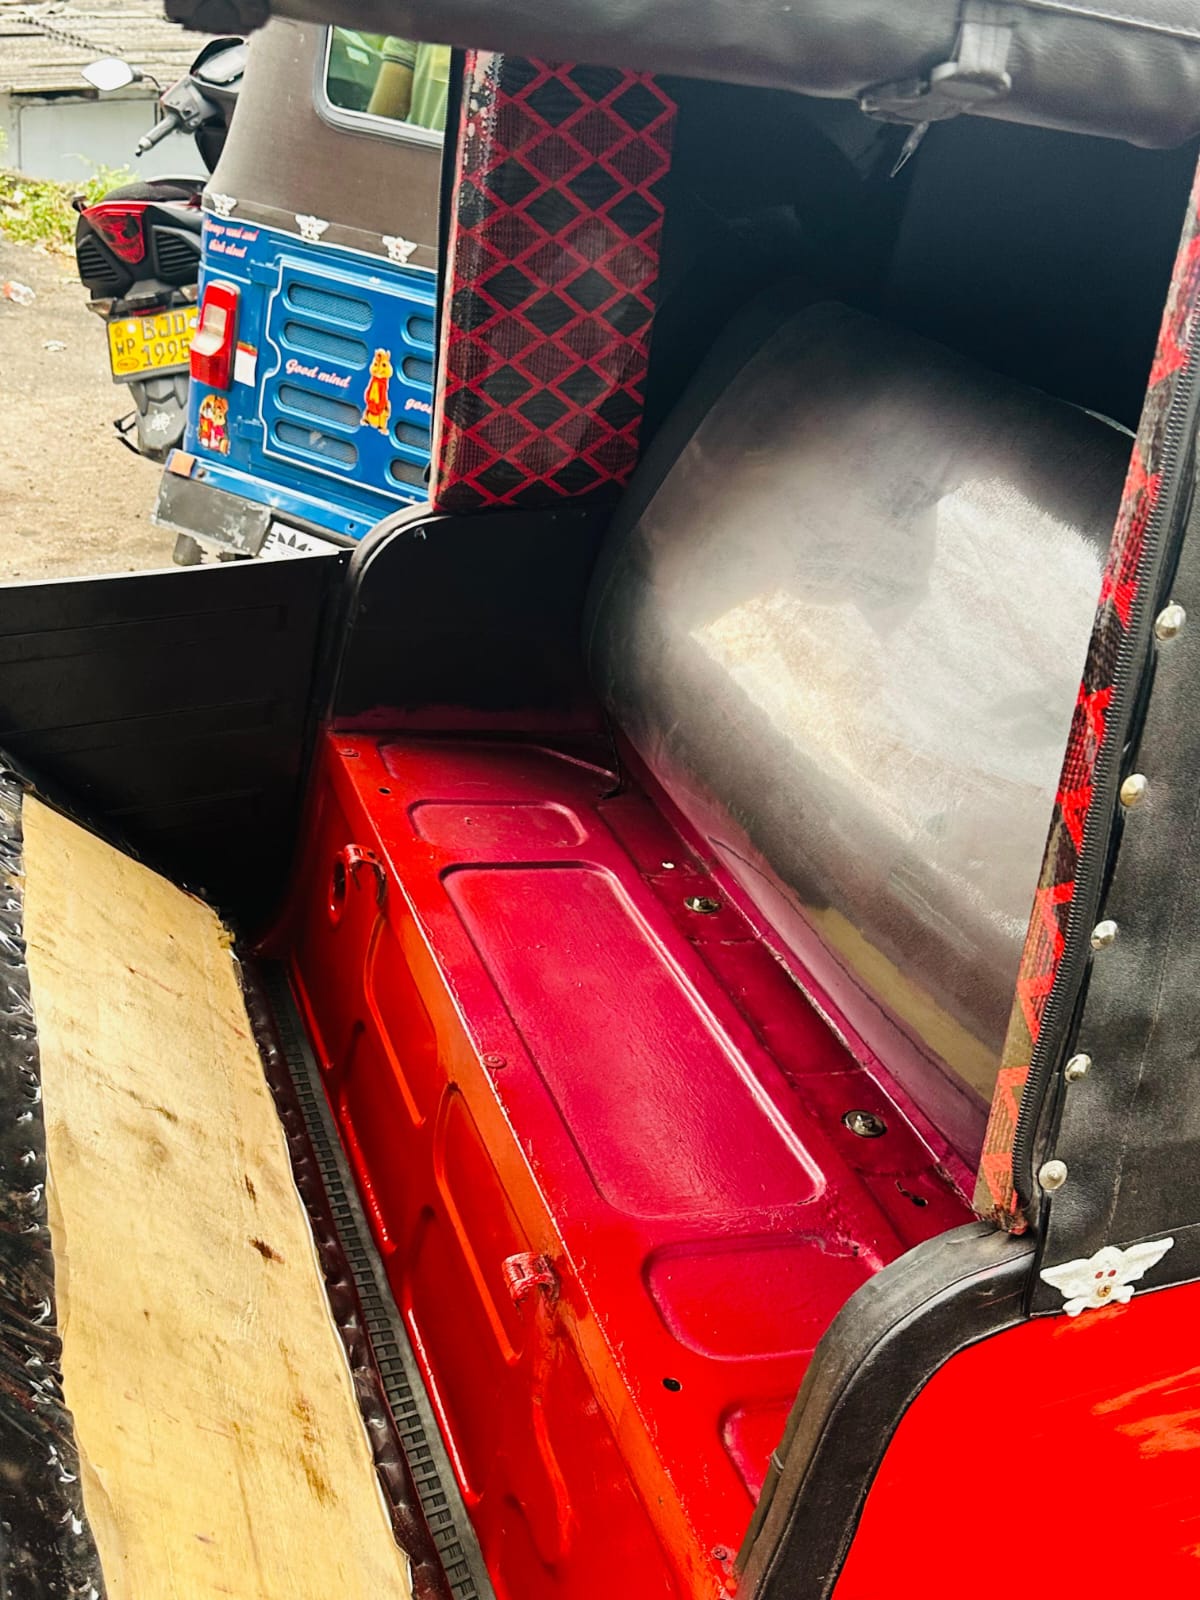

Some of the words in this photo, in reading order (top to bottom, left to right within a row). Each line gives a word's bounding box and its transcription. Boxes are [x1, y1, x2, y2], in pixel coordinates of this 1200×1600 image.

[141, 313, 186, 341] BJD
[115, 338, 136, 357] WP
[141, 337, 191, 367] 1995
[285, 359, 319, 378] Good
[317, 371, 352, 388] mind
